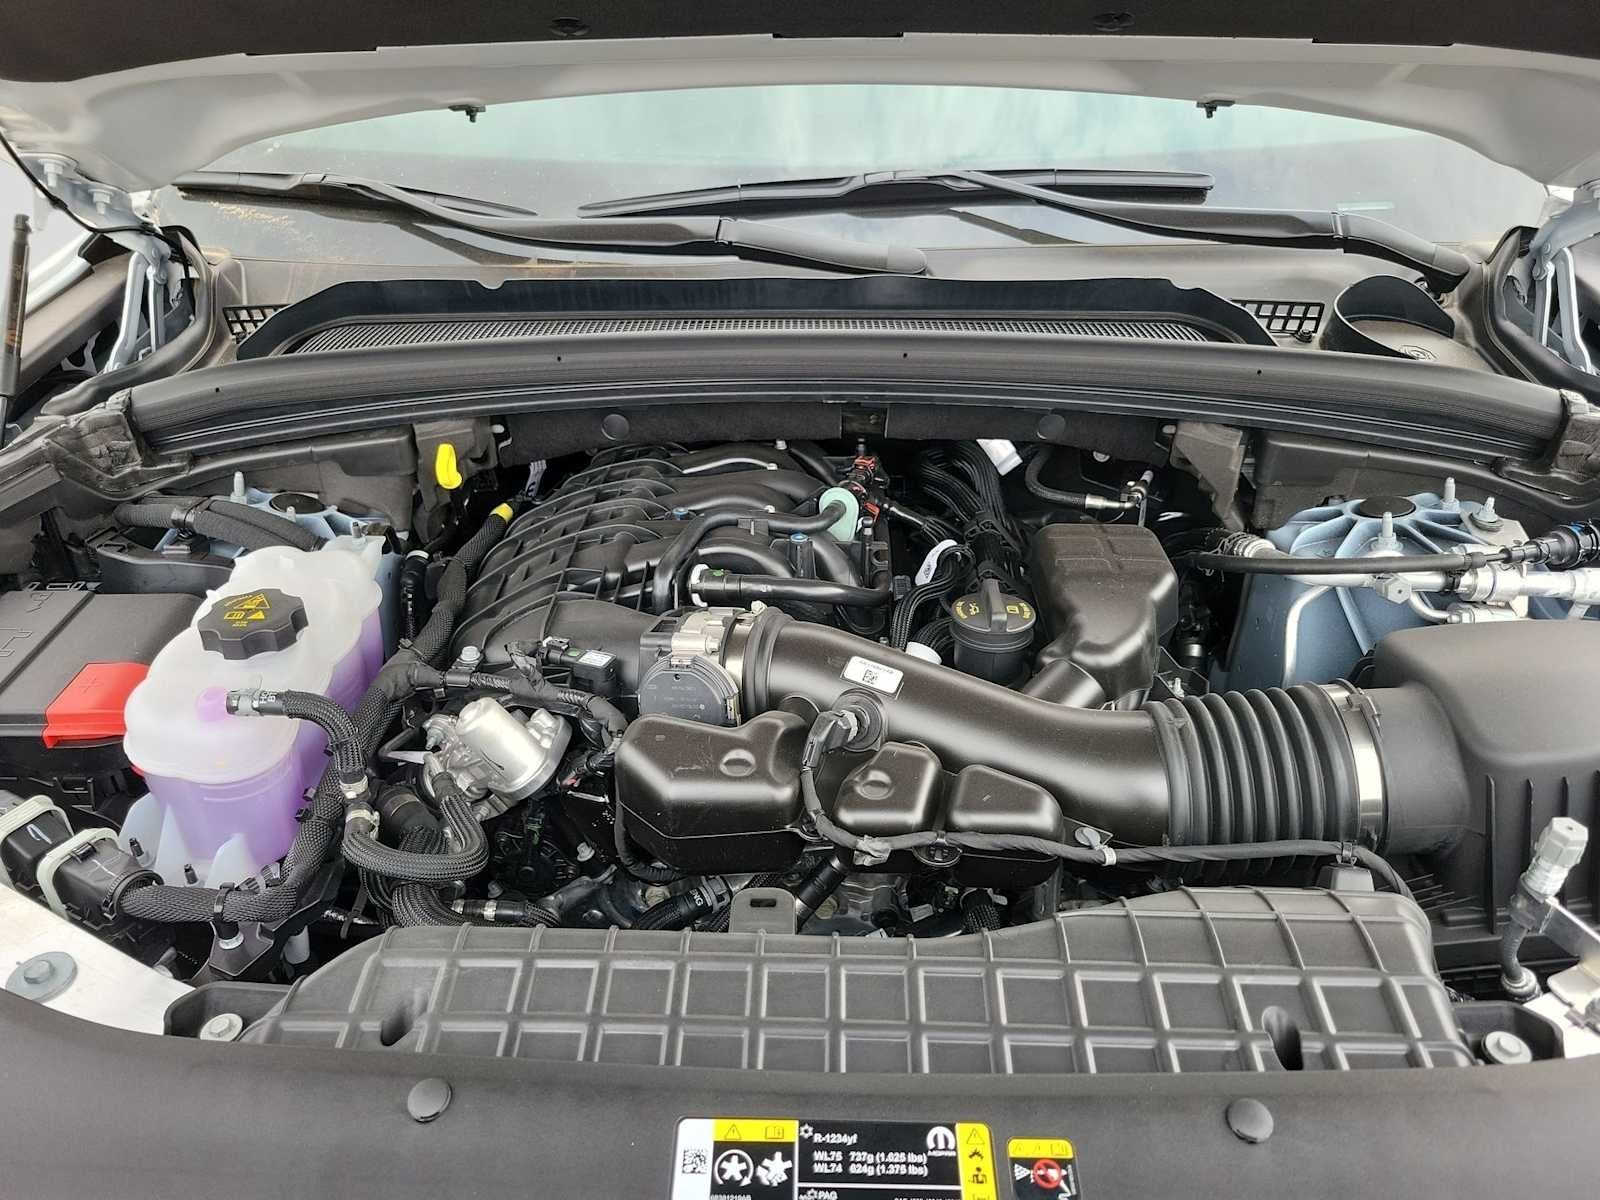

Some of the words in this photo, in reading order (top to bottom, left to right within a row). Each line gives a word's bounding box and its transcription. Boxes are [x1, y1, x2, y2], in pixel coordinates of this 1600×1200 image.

[813, 1133, 858, 1146] R-1234yf
[813, 1150, 843, 1162] WL75
[849, 1151, 874, 1164] 737g
[875, 1151, 906, 1164] (1.625
[907, 1151, 928, 1165] lbs)
[813, 1162, 843, 1174] WL74
[849, 1163, 875, 1176] 624g
[876, 1164, 907, 1176] (1.375
[908, 1164, 929, 1177] lbs)
